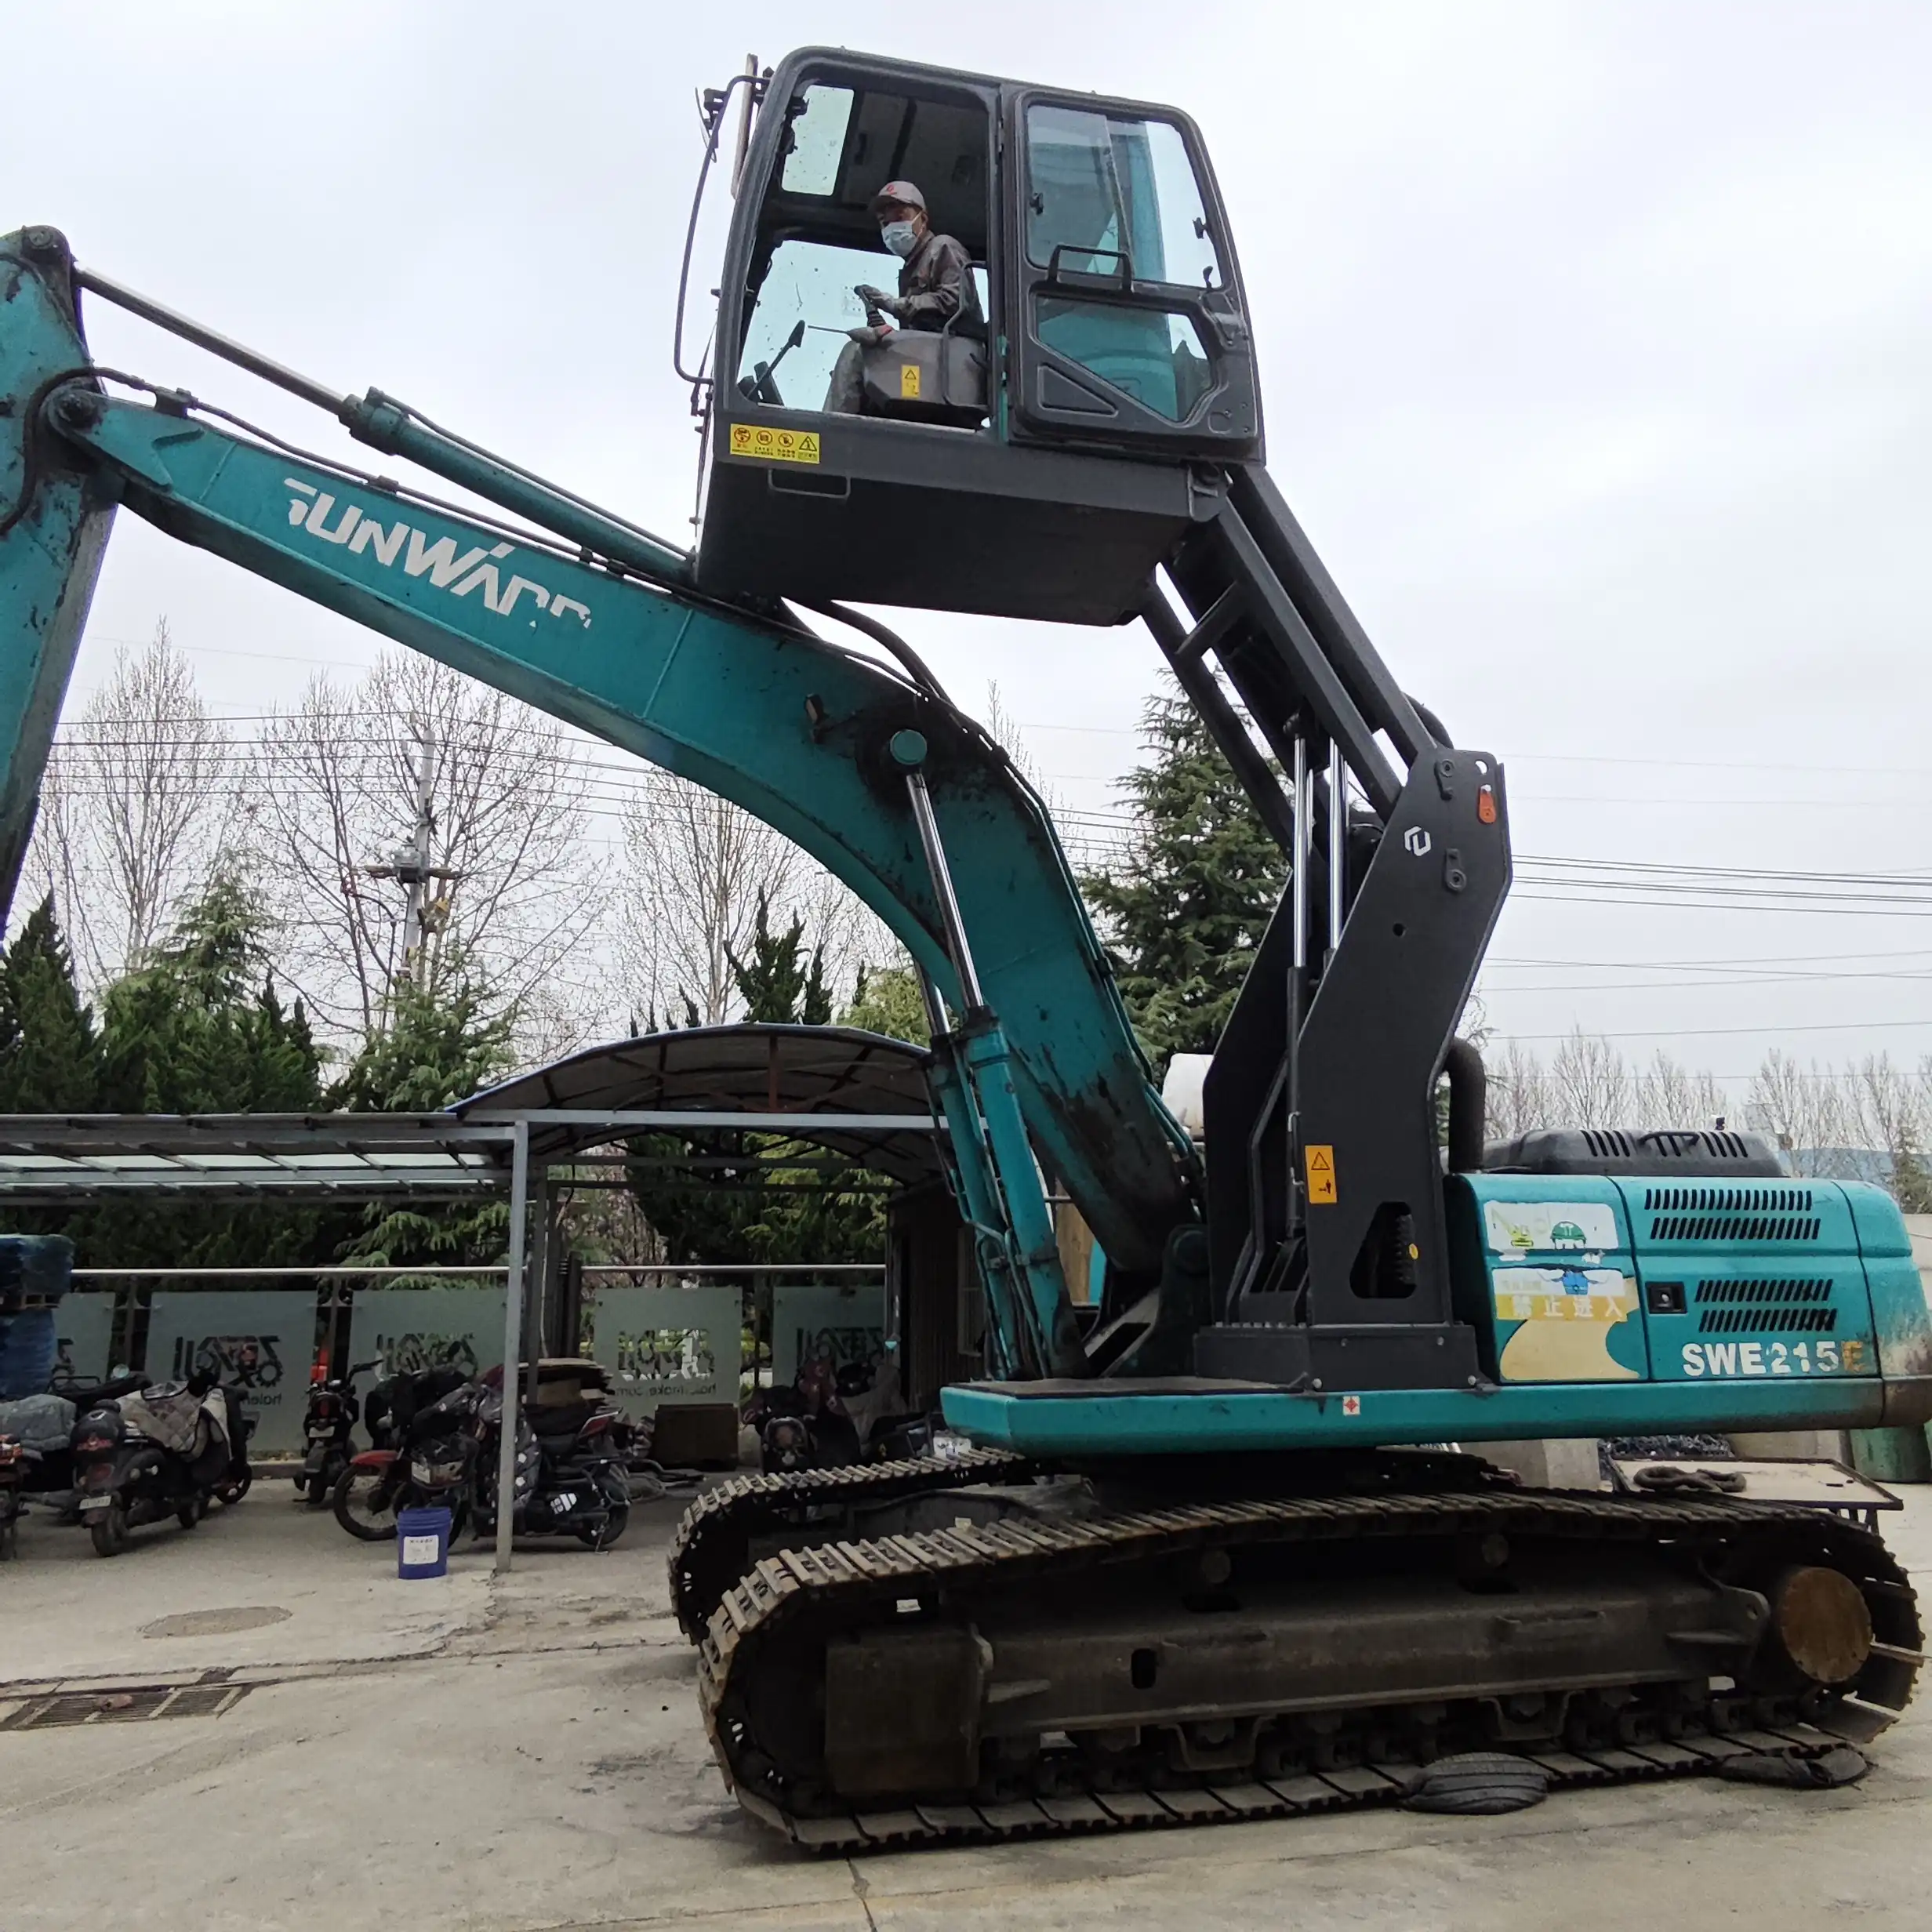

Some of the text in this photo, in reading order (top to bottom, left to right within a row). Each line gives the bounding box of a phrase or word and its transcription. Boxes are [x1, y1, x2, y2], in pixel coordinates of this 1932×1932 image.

[1512, 1295, 1623, 1318] 禁止进入
[1682, 1341, 1864, 1376] SWE215E
